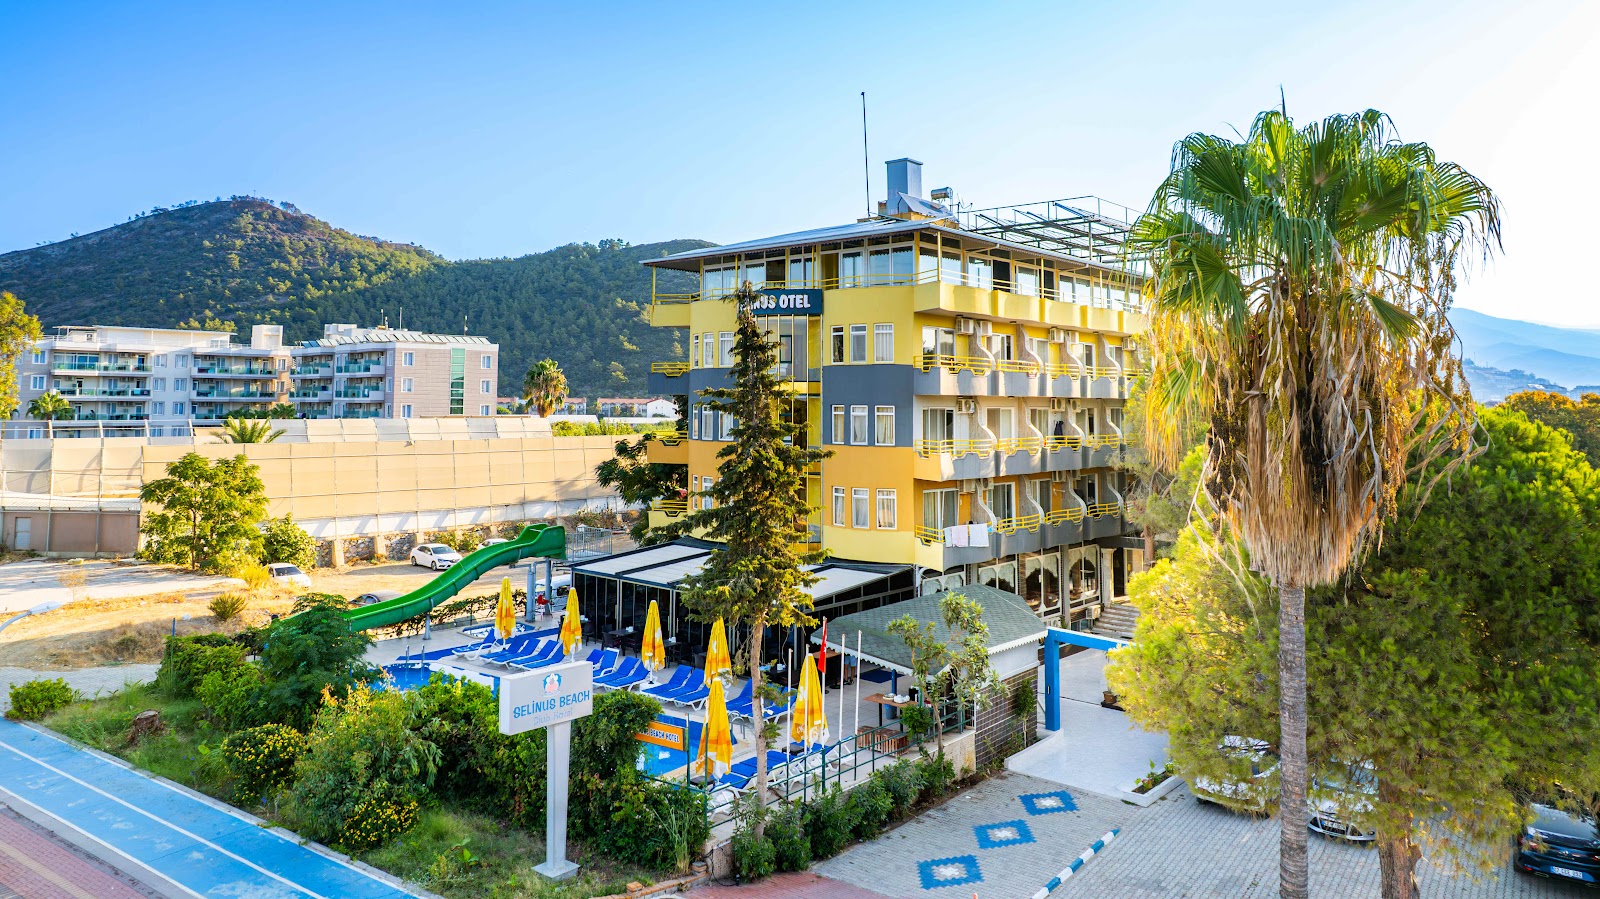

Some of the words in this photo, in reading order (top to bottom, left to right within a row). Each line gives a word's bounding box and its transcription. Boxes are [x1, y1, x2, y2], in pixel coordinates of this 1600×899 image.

[779, 294, 811, 309] OTEL
[513, 698, 556, 719] SELİNUS
[559, 690, 590, 708] BEACH
[553, 707, 573, 721] Hotel
[665, 732, 680, 743] HOTEL
